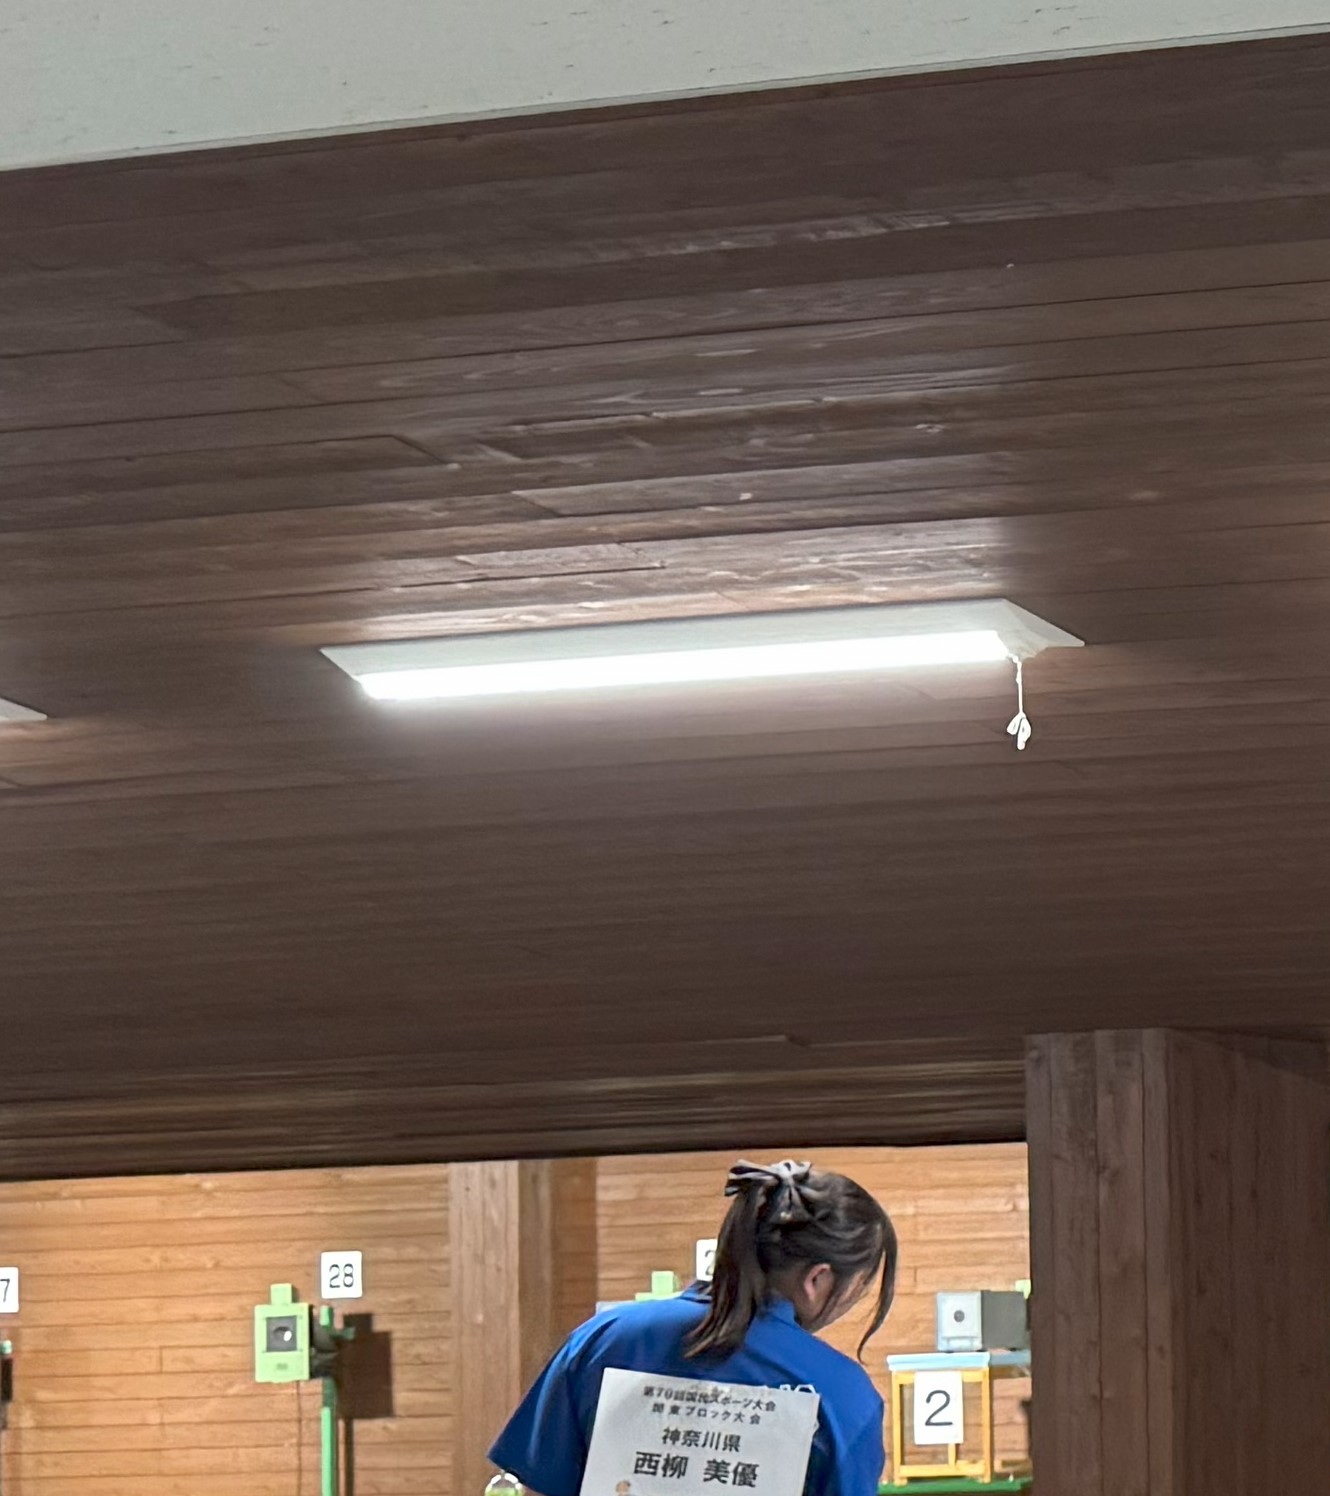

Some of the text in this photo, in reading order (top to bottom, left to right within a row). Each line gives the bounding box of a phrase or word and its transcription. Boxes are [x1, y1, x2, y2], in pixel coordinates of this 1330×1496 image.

[329, 1263, 354, 1288] 28
[0, 1278, 10, 1303] 7
[924, 1390, 953, 1426] 2
[662, 1427, 741, 1453] 神奈川県
[633, 1451, 760, 1488] 西柳 美優
